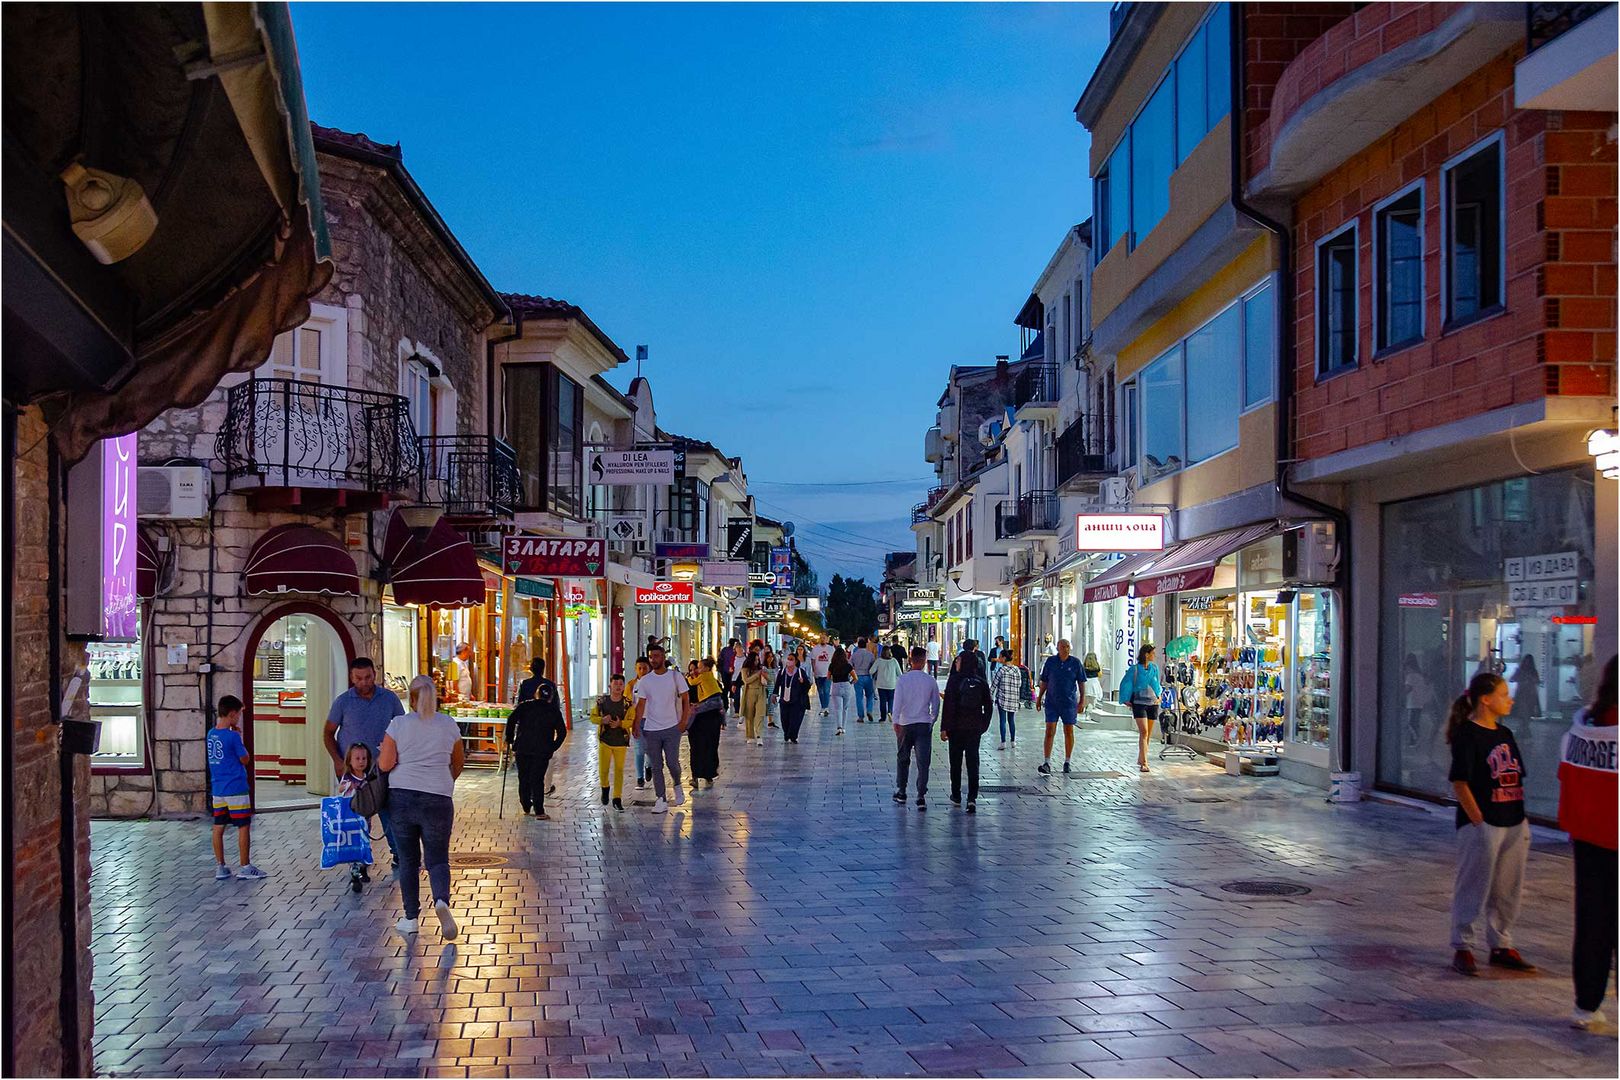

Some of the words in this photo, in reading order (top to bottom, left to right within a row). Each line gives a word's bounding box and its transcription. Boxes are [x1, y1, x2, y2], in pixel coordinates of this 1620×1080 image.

[622, 453, 631, 462] DI
[633, 453, 648, 462] LEA
[508, 540, 600, 557] ЗЛАТАРА
[729, 527, 751, 558] ABEDIN
[1509, 562, 1520, 577] СЕ
[1156, 573, 1186, 594] adam's
[639, 592, 690, 603] optikacentar
